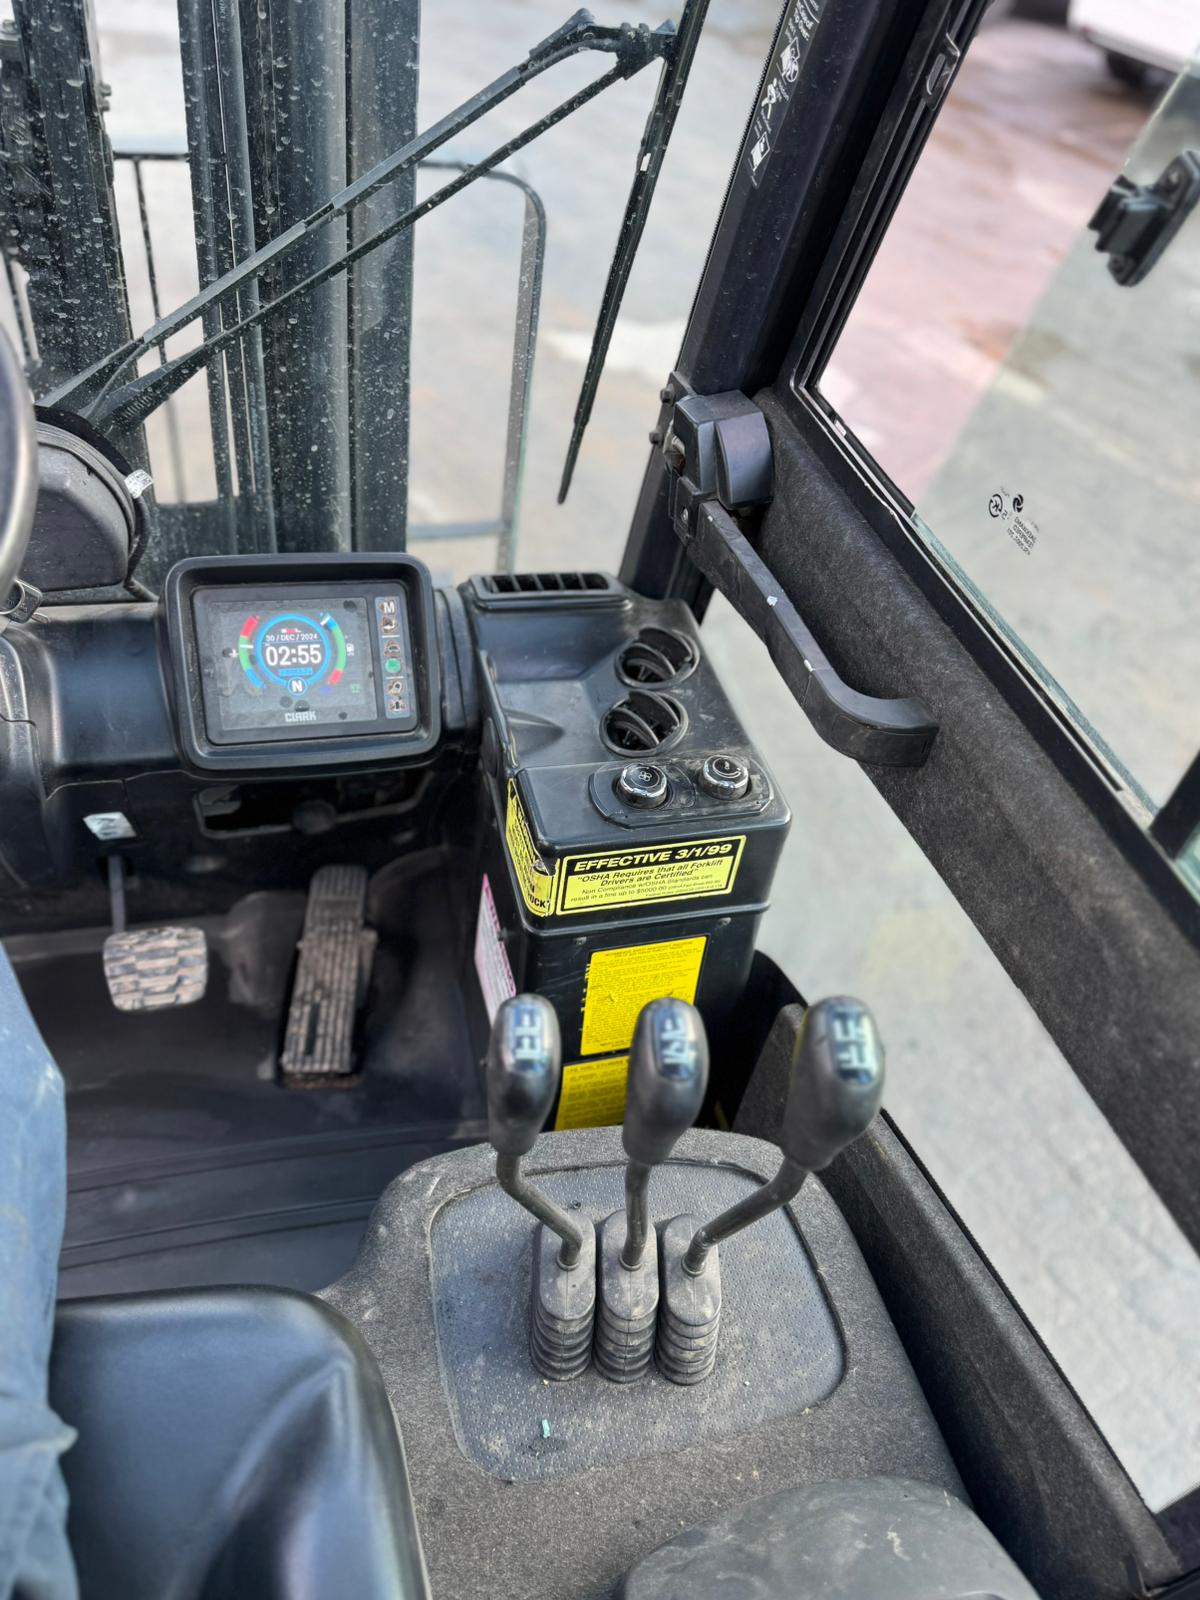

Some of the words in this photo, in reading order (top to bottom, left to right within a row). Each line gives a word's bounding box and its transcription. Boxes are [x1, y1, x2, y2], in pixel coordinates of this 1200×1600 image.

[383, 601, 395, 613] M
[300, 633, 318, 641] 2024
[265, 644, 322, 666] 02:55
[291, 680, 303, 692] N
[284, 711, 317, 722] CLARK
[573, 852, 671, 873] EFFECTIVE
[674, 843, 734, 860] 3/1/99
[577, 872, 610, 883] "OSHA
[613, 867, 655, 878] Requires
[657, 864, 676, 873] that
[690, 859, 724, 869] Forklift
[600, 877, 634, 887] Drivers
